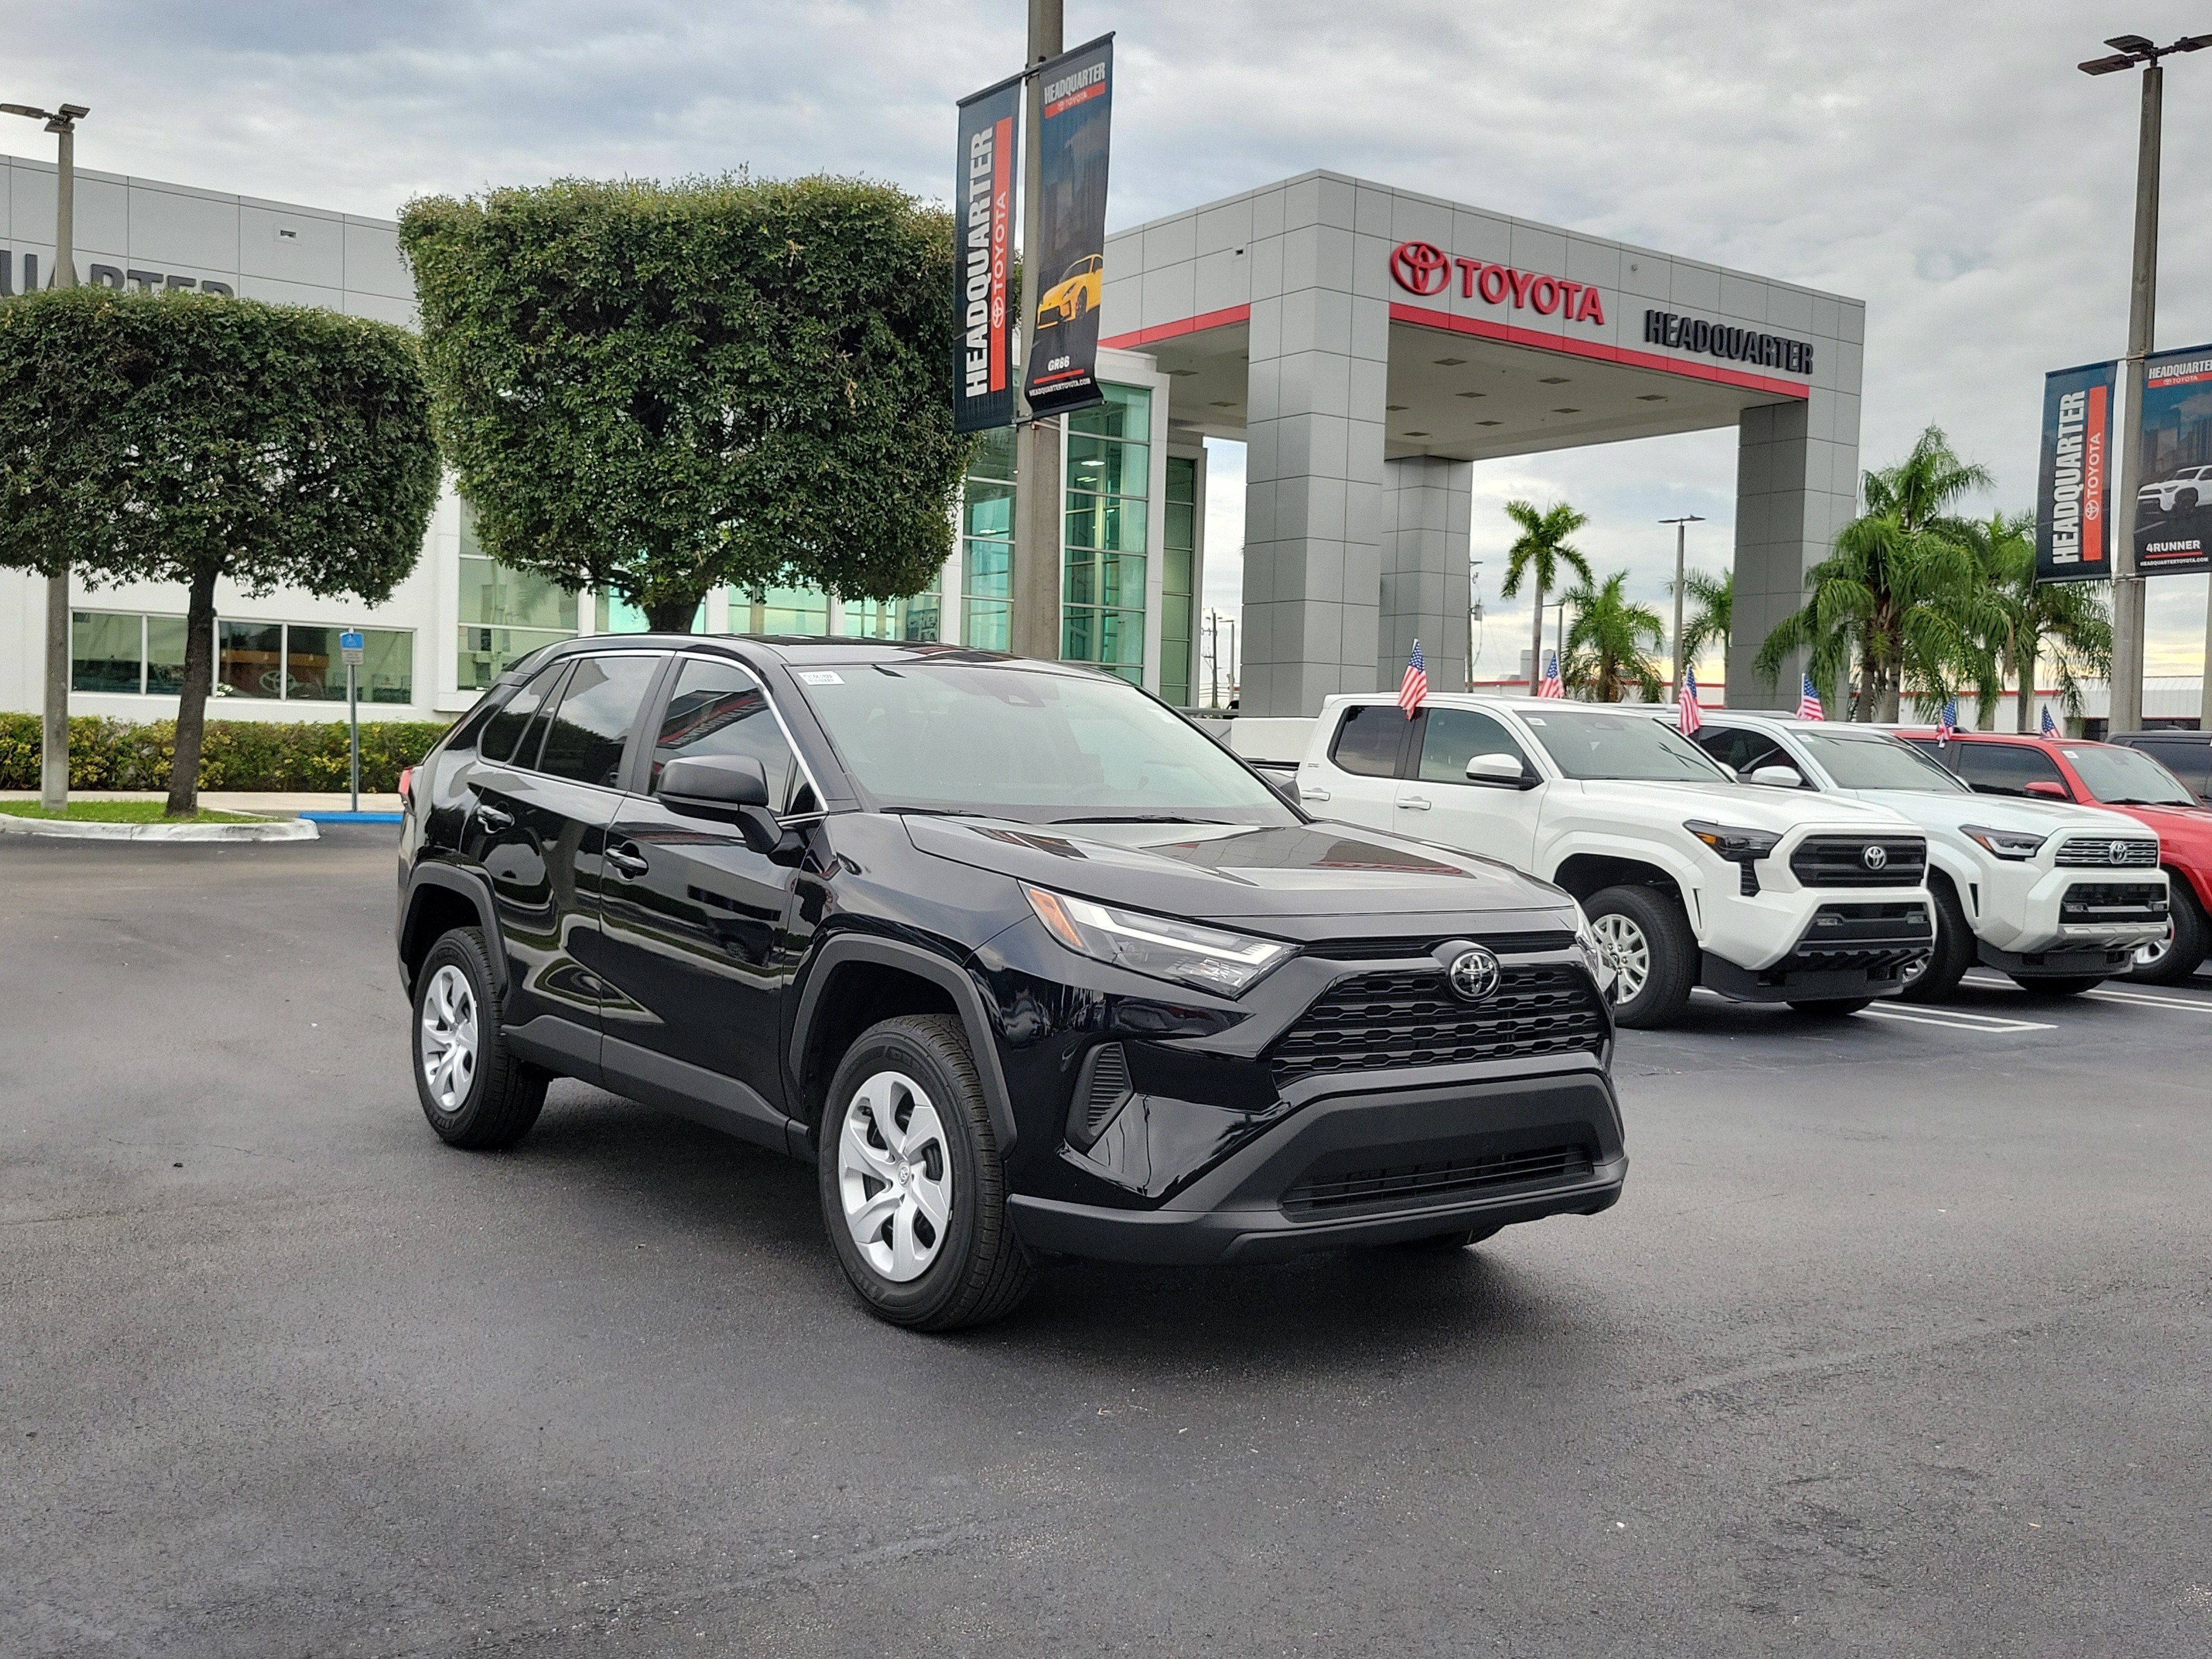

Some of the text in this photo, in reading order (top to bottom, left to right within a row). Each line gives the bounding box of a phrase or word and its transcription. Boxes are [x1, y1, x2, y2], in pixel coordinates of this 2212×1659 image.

[1045, 62, 1106, 105] HEADQUARTER
[966, 127, 994, 398] HEADQUARTER
[993, 192, 1007, 295] TOYOTA
[1456, 257, 1605, 325] TOYOTA
[1645, 309, 1813, 375] HEADQUARTER
[2173, 375, 2198, 383] TOYOTA
[2052, 390, 2085, 565] HEADQUARTER
[2086, 432, 2101, 498] TOYOTA
[2146, 540, 2201, 552] 4RUNNER
